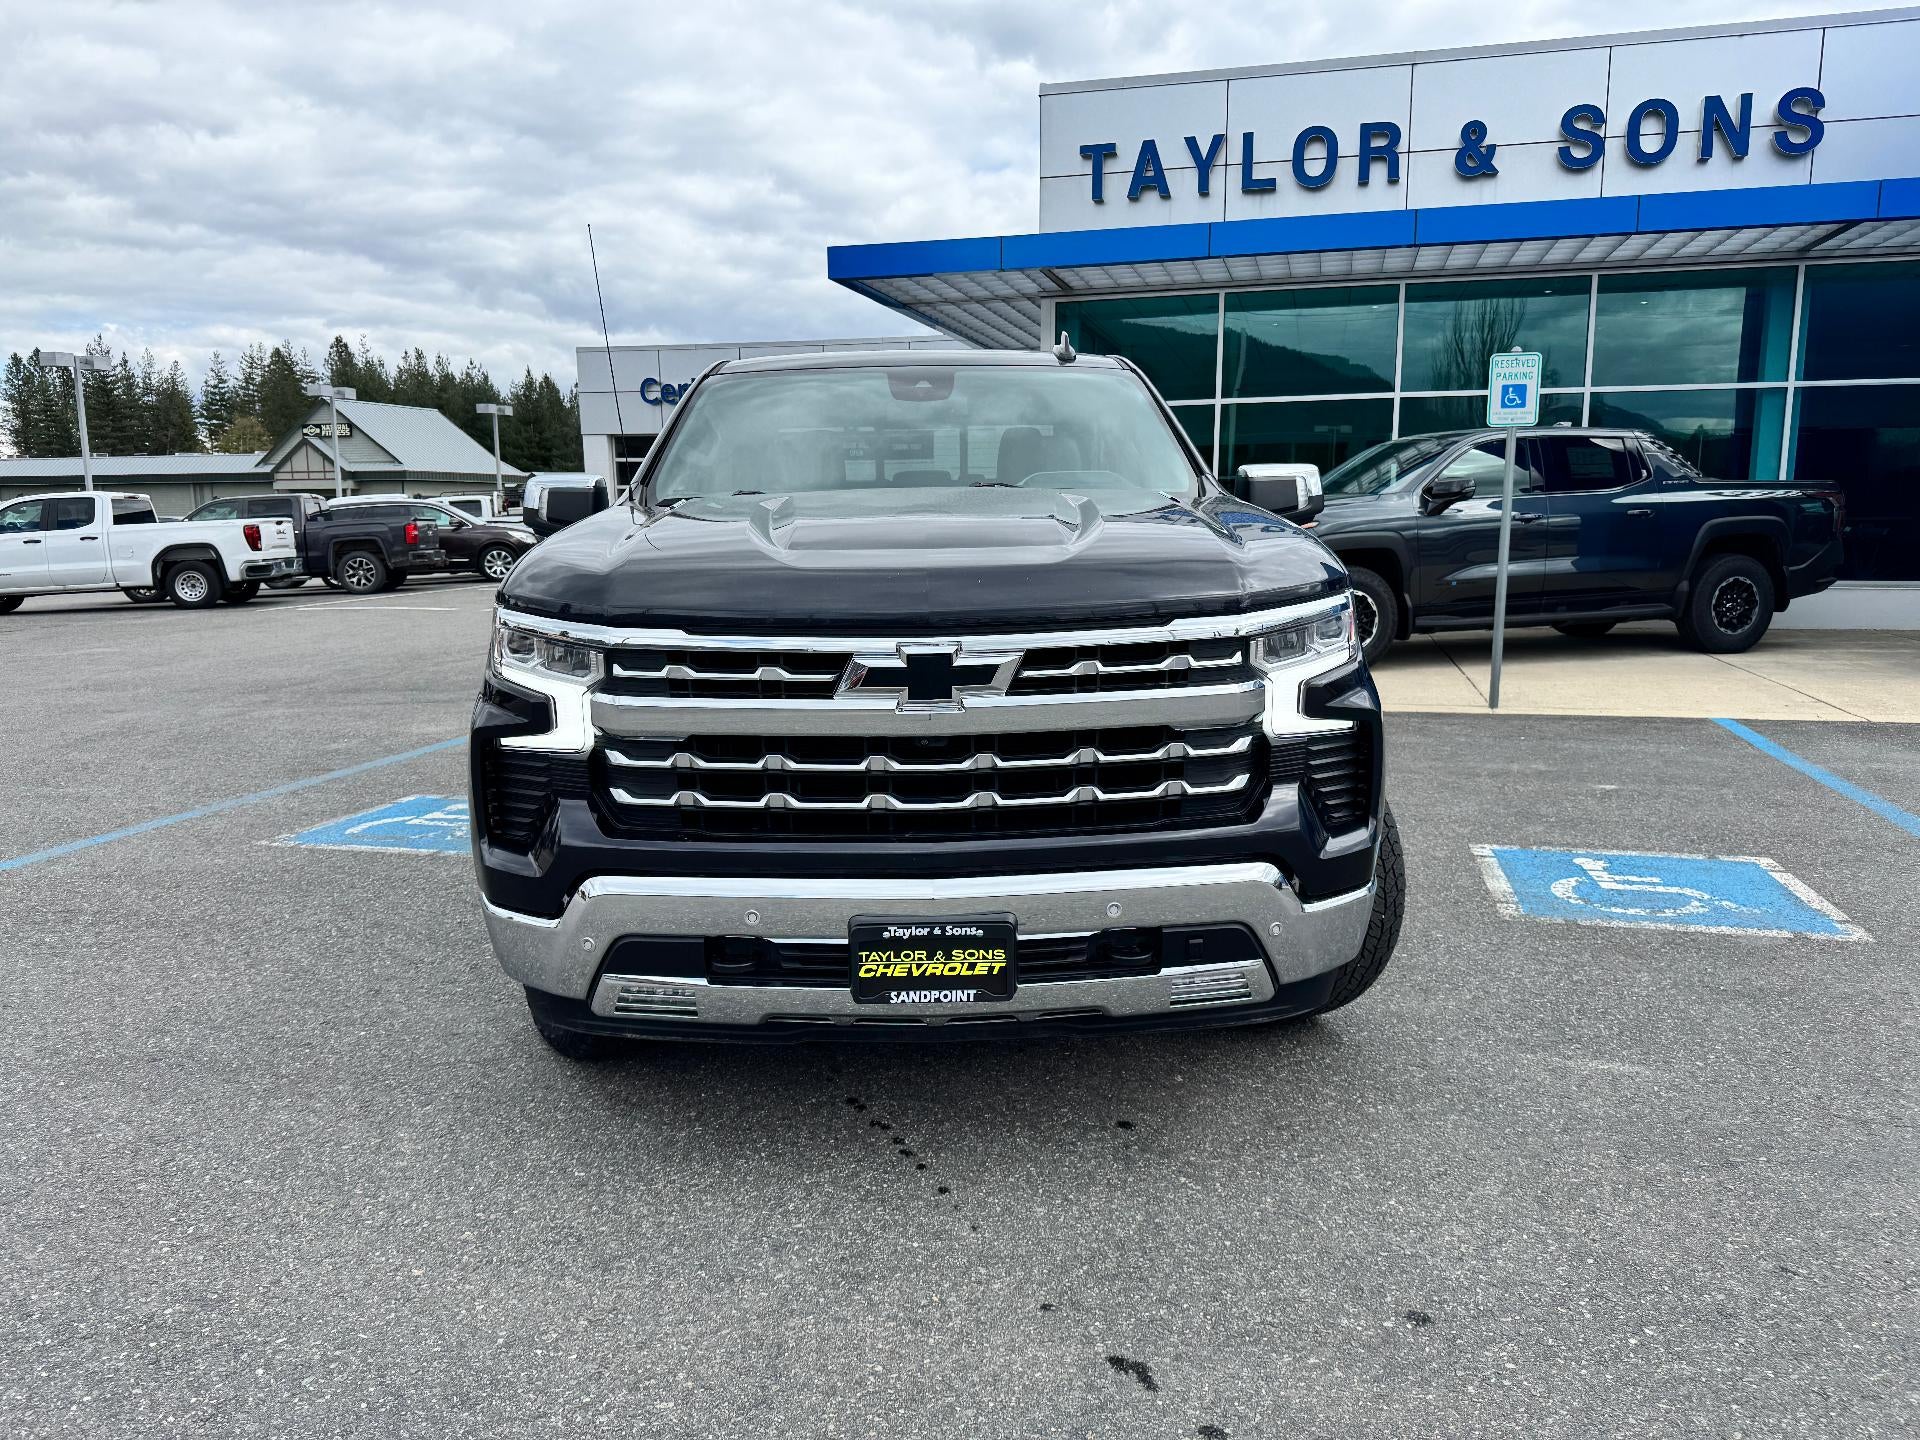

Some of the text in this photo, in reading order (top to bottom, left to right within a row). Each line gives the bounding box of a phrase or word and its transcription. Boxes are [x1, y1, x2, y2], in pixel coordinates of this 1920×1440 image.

[1079, 86, 1826, 203] TAYLOR & SONS
[1494, 358, 1537, 369] RESERVED
[1495, 371, 1534, 381] PARKING
[887, 925, 977, 939] Taylor & Sons
[858, 949, 1006, 963] TAYLOR & SONS
[858, 962, 1007, 978] CHEVROLET
[889, 989, 977, 1004] SANDPOINT
